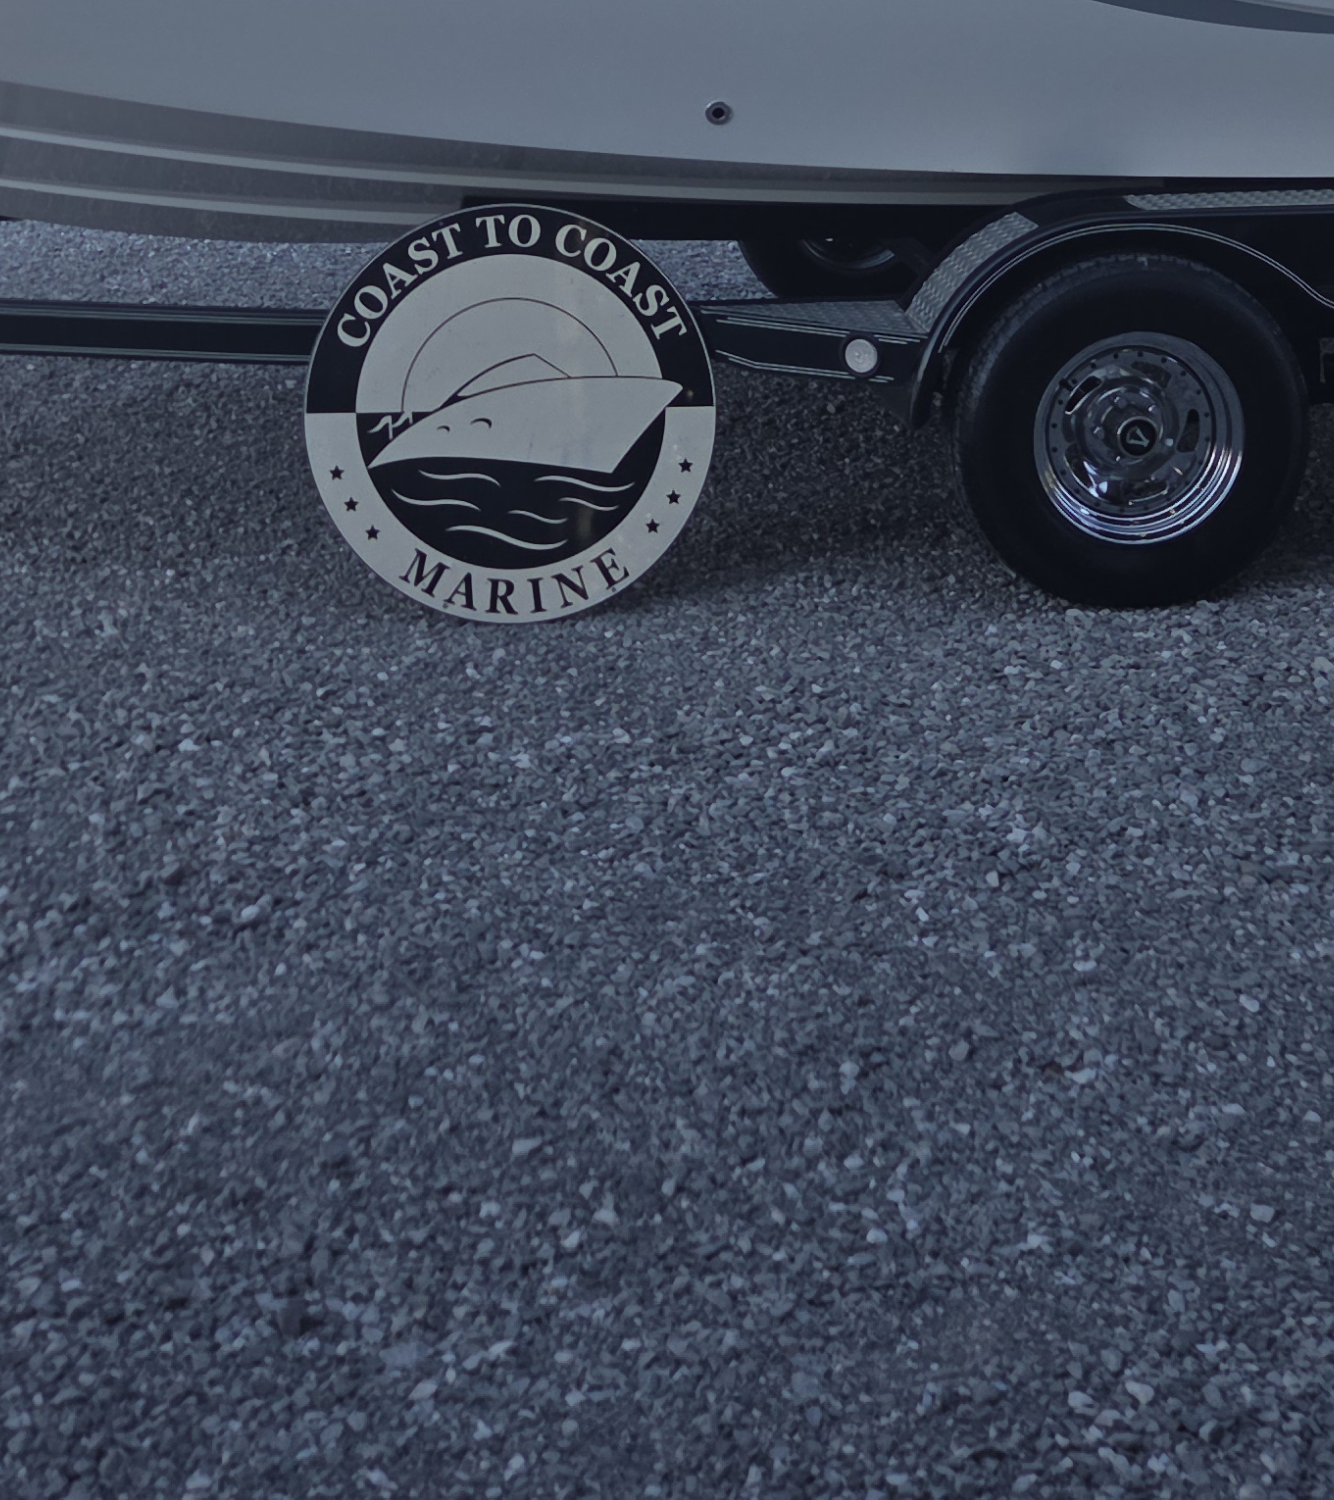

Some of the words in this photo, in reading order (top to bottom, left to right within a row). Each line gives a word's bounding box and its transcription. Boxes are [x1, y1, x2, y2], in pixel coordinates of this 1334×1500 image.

[336, 222, 463, 349] COAST
[475, 214, 542, 249] TO
[555, 223, 686, 341] COAST
[400, 547, 630, 616] MARINE
